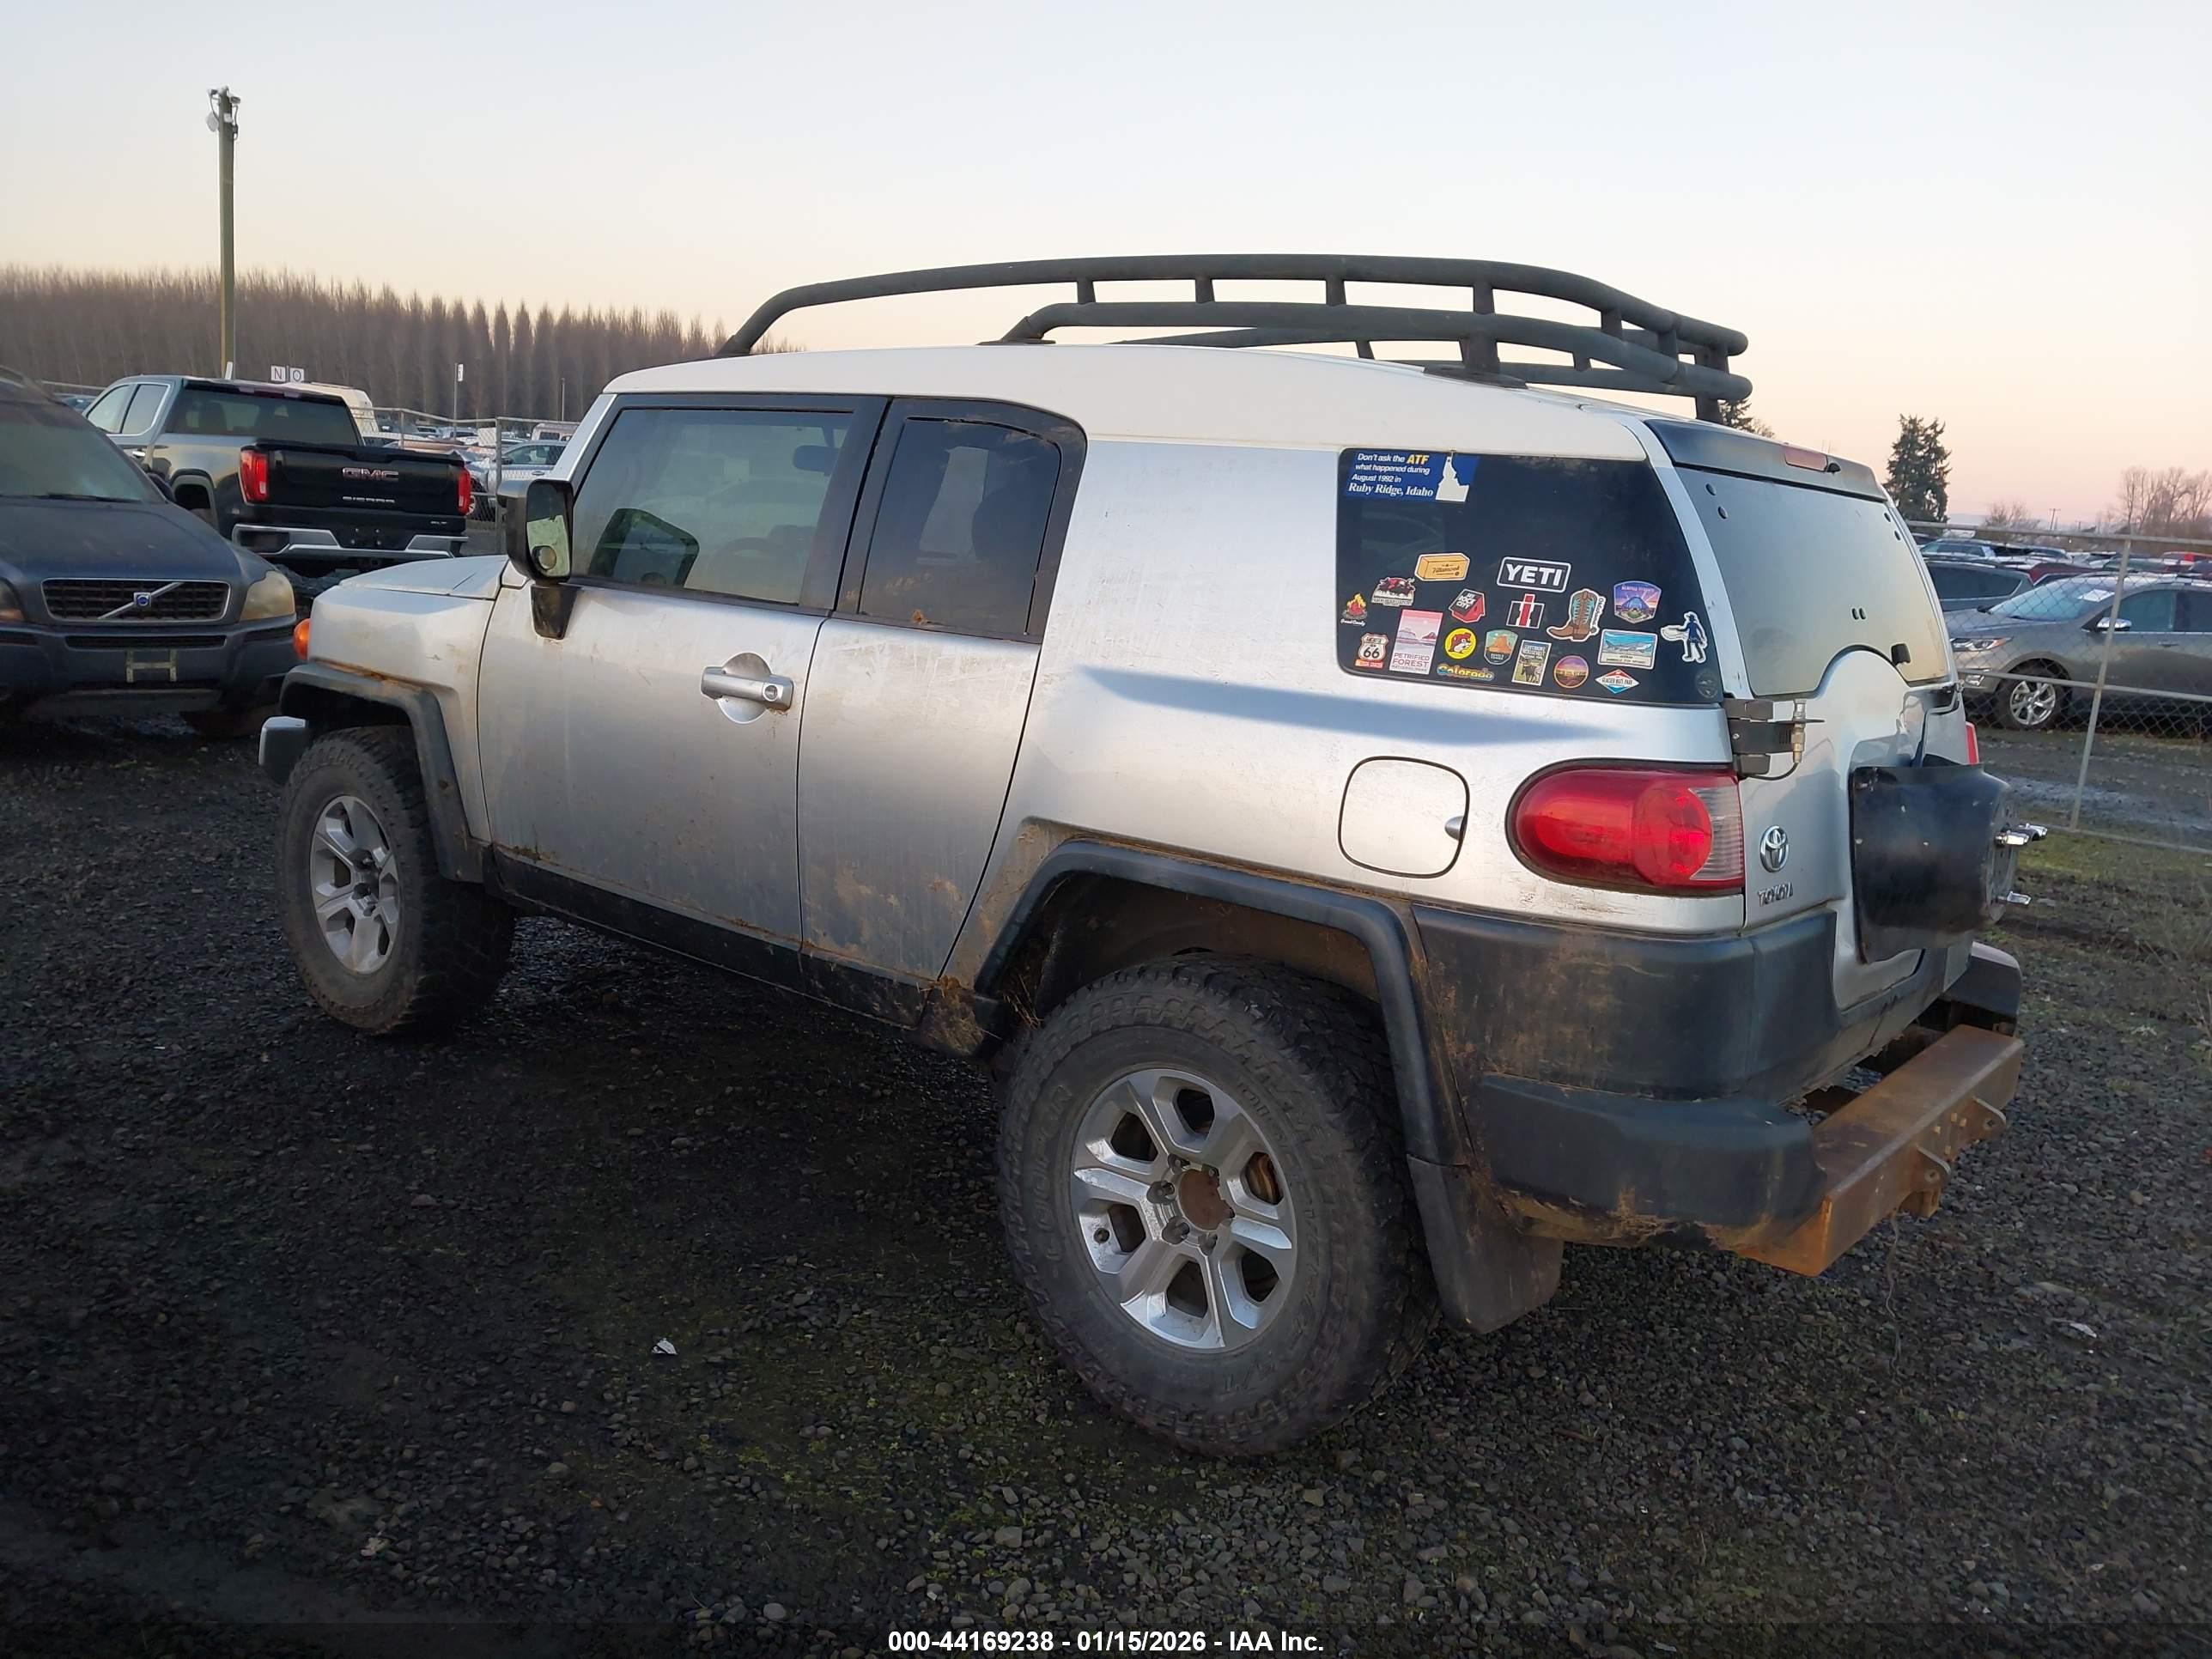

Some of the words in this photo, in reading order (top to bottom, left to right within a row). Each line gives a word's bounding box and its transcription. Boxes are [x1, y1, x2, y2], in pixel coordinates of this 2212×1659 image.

[273, 368, 283, 380] N
[292, 370, 301, 381] O
[1357, 453, 1377, 461] Don't
[1392, 454, 1406, 463] the
[1406, 453, 1430, 465] ATF
[342, 467, 399, 481] GMC
[1372, 465, 1407, 473] happened
[1407, 466, 1431, 476] during
[1352, 473, 1377, 483] August
[1348, 482, 1374, 495] Ruby
[1374, 483, 1404, 496] Ridge,
[1405, 485, 1434, 497] Idaho
[1505, 563, 1563, 586] YETI
[1455, 601, 1471, 610] CITY
[1458, 595, 1477, 605] ROCK
[1363, 647, 1380, 659] 66
[1394, 653, 1430, 661] PETRIFIED
[1392, 659, 1430, 667] FOREST
[1437, 665, 1494, 680] Colorado
